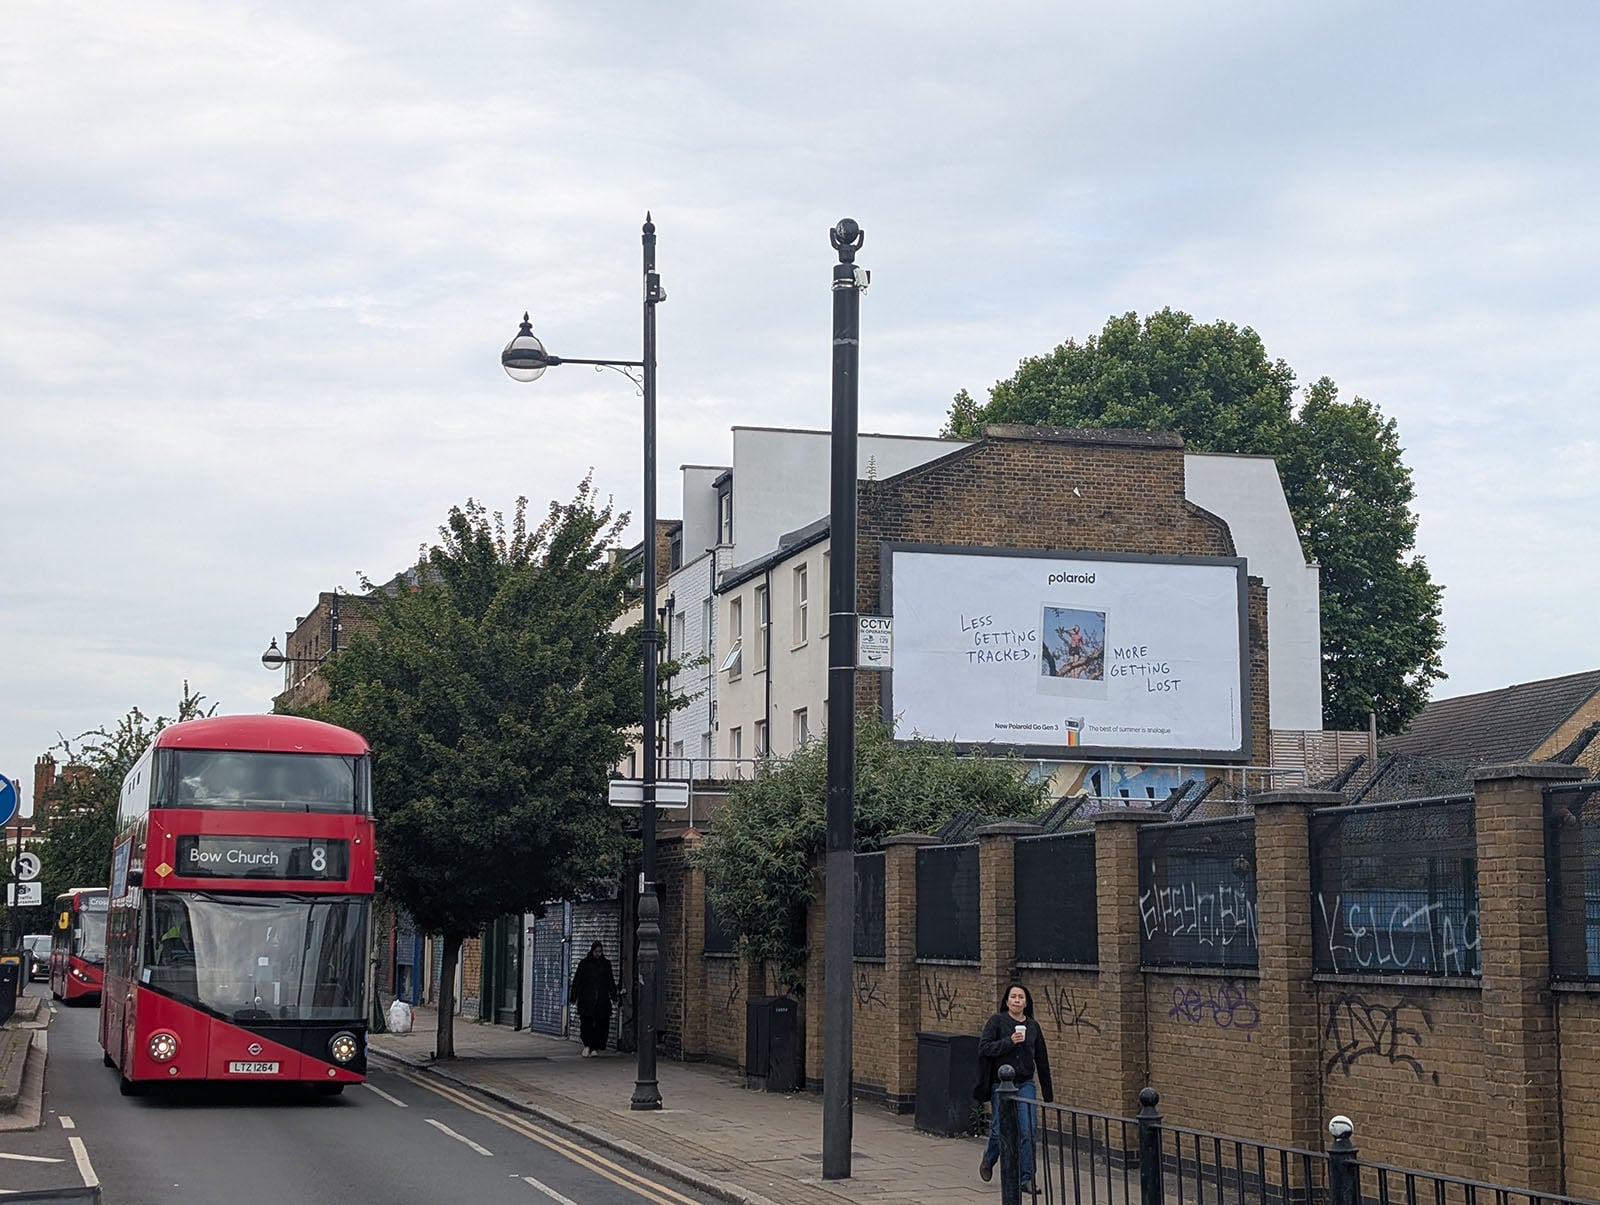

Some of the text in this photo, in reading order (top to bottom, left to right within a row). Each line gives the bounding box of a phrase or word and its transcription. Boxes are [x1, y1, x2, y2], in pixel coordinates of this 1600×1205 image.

[1048, 572, 1096, 585] polaroid
[860, 619, 891, 629] CCTV
[960, 614, 993, 632] LESS
[966, 649, 1037, 664] TRACKED,
[1113, 646, 1149, 660] MORE
[1147, 679, 1182, 693] LOST
[1099, 725, 1112, 733] best
[190, 847, 327, 872] Bow Church 8
[234, 1063, 273, 1072] LTZ 1264
